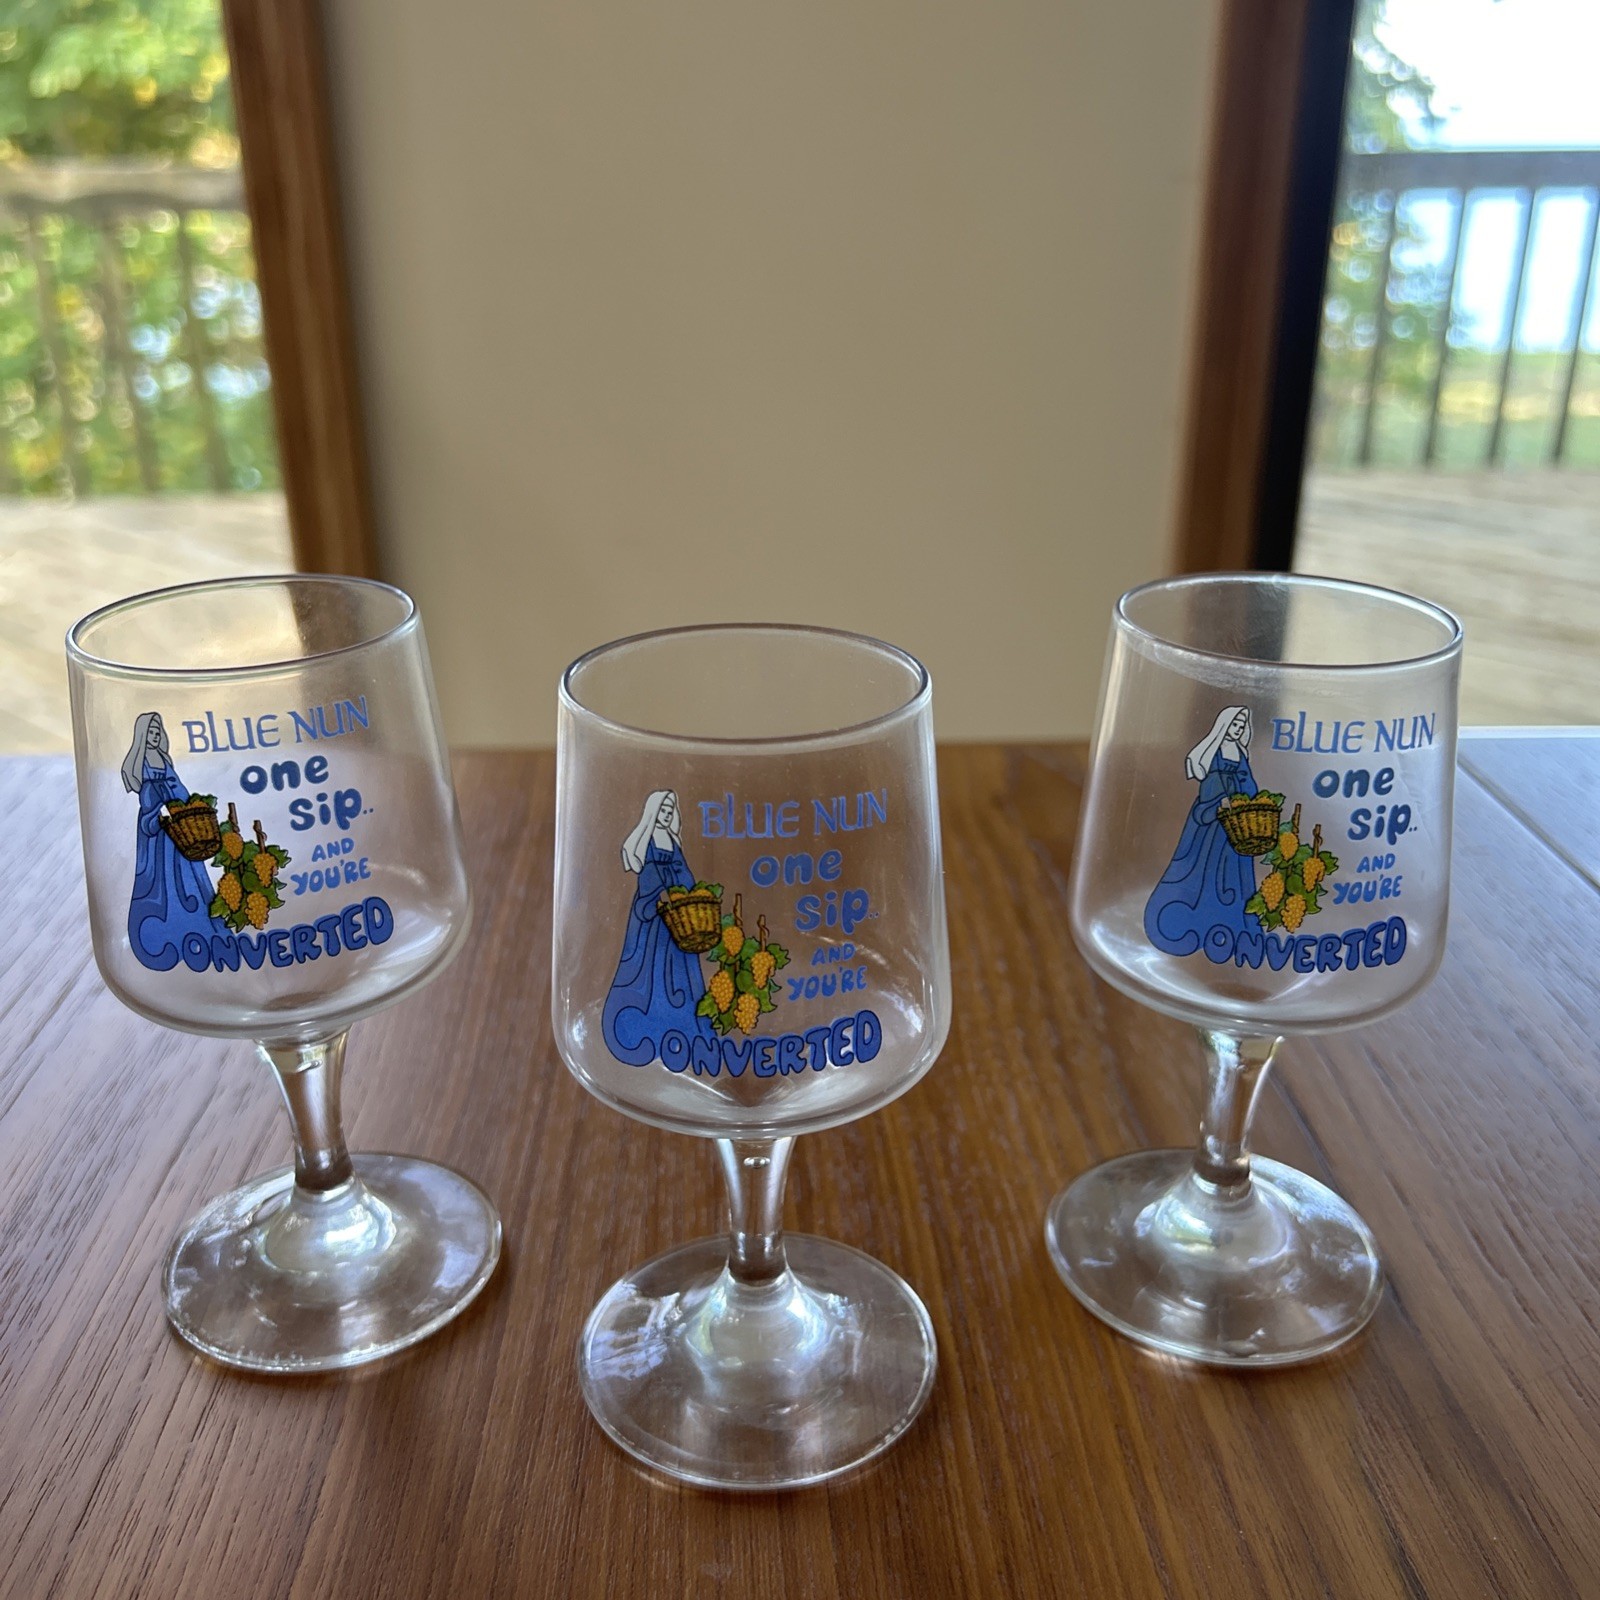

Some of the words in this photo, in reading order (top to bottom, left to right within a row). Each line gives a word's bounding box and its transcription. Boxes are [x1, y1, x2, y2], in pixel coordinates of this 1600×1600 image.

[287, 695, 370, 743] NUN
[1373, 713, 1436, 753] NUN
[240, 755, 329, 794] one
[1312, 767, 1395, 799] one
[812, 789, 888, 836] NUN
[311, 838, 354, 862] AND
[751, 849, 842, 887] one
[1356, 853, 1395, 874] AND
[290, 857, 371, 896] YOU'RE
[1333, 875, 1403, 905] YOU'RE
[128, 896, 394, 972] CONVERTED
[1144, 901, 1407, 974] CONVERTED
[811, 943, 855, 966] AND
[787, 966, 867, 1001] YOU'RE
[602, 1006, 882, 1078] CONVERTED
